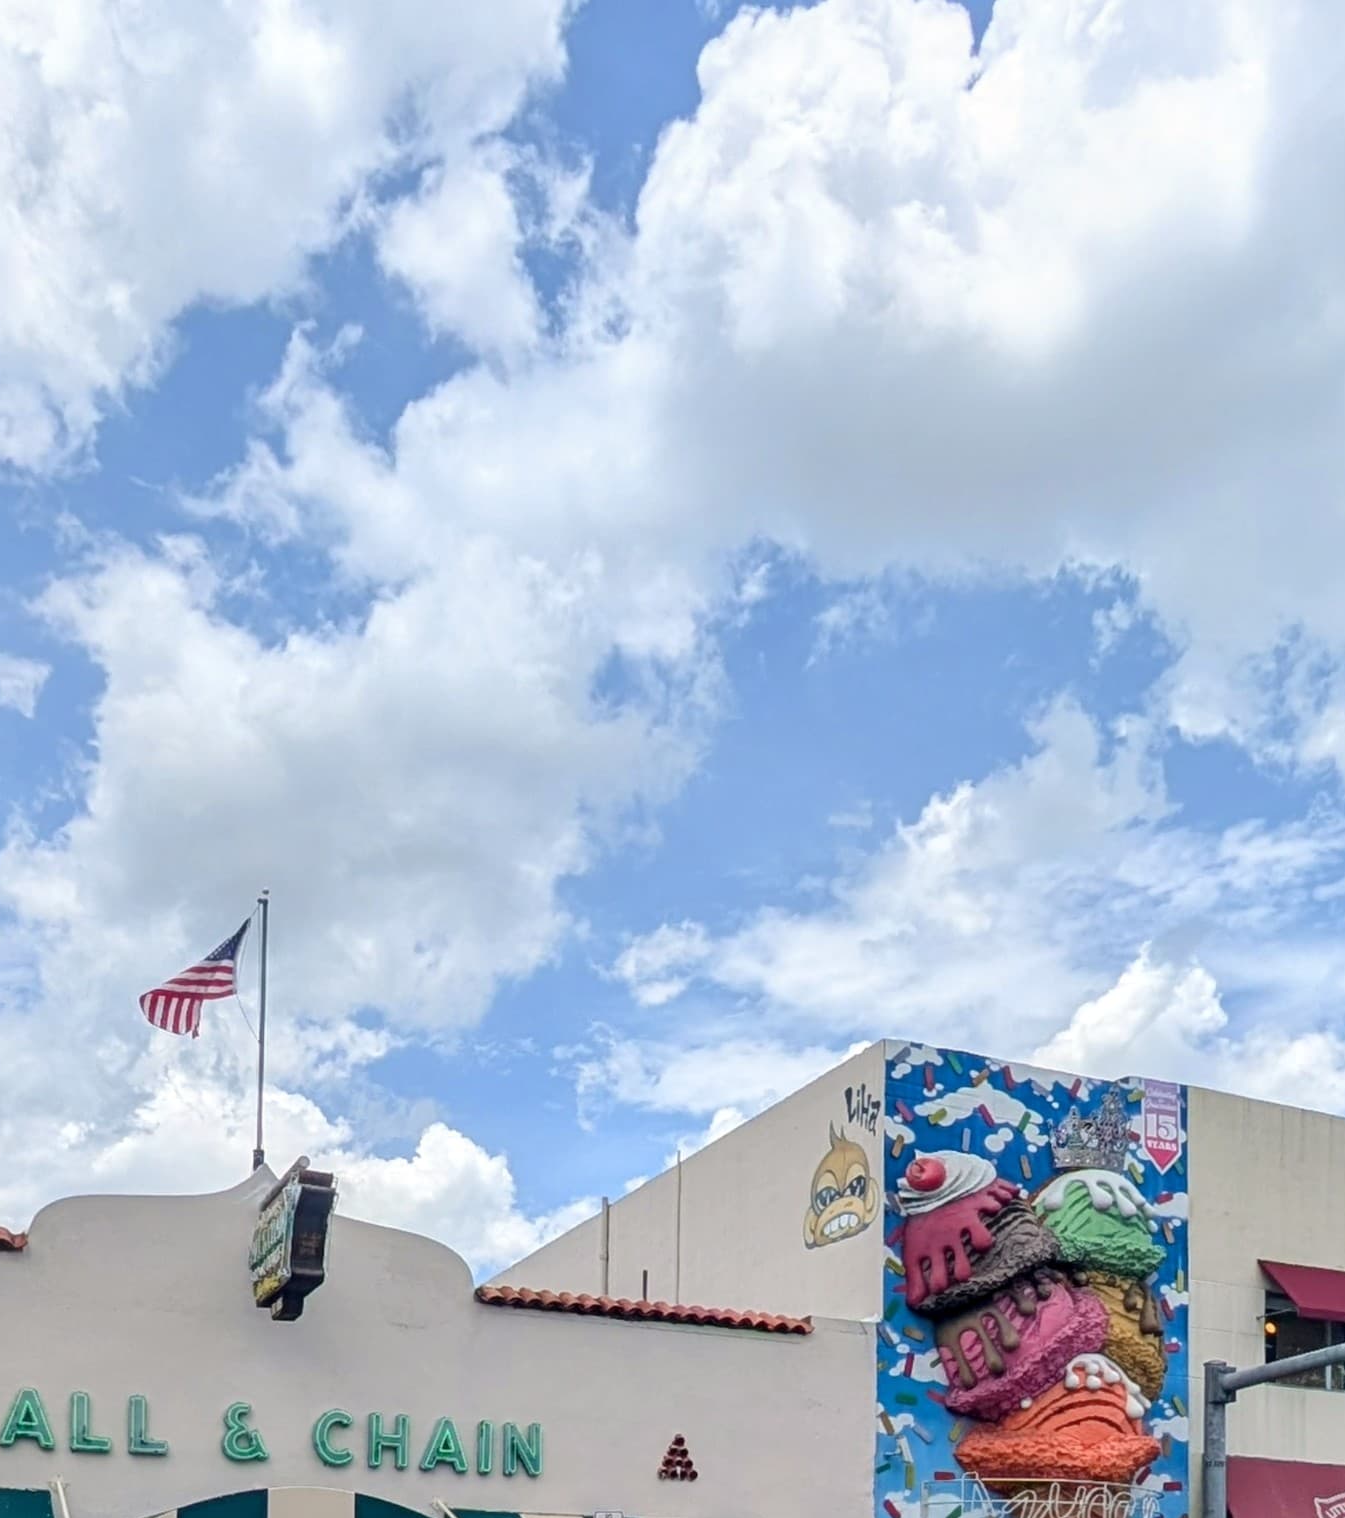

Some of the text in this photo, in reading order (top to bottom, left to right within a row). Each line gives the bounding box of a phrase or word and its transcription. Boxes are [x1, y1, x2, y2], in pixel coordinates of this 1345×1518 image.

[1146, 1113, 1177, 1141] 15
[1146, 1140, 1177, 1152] YEARS
[222, 1402, 269, 1463] &
[312, 1408, 544, 1478] CHAIN
